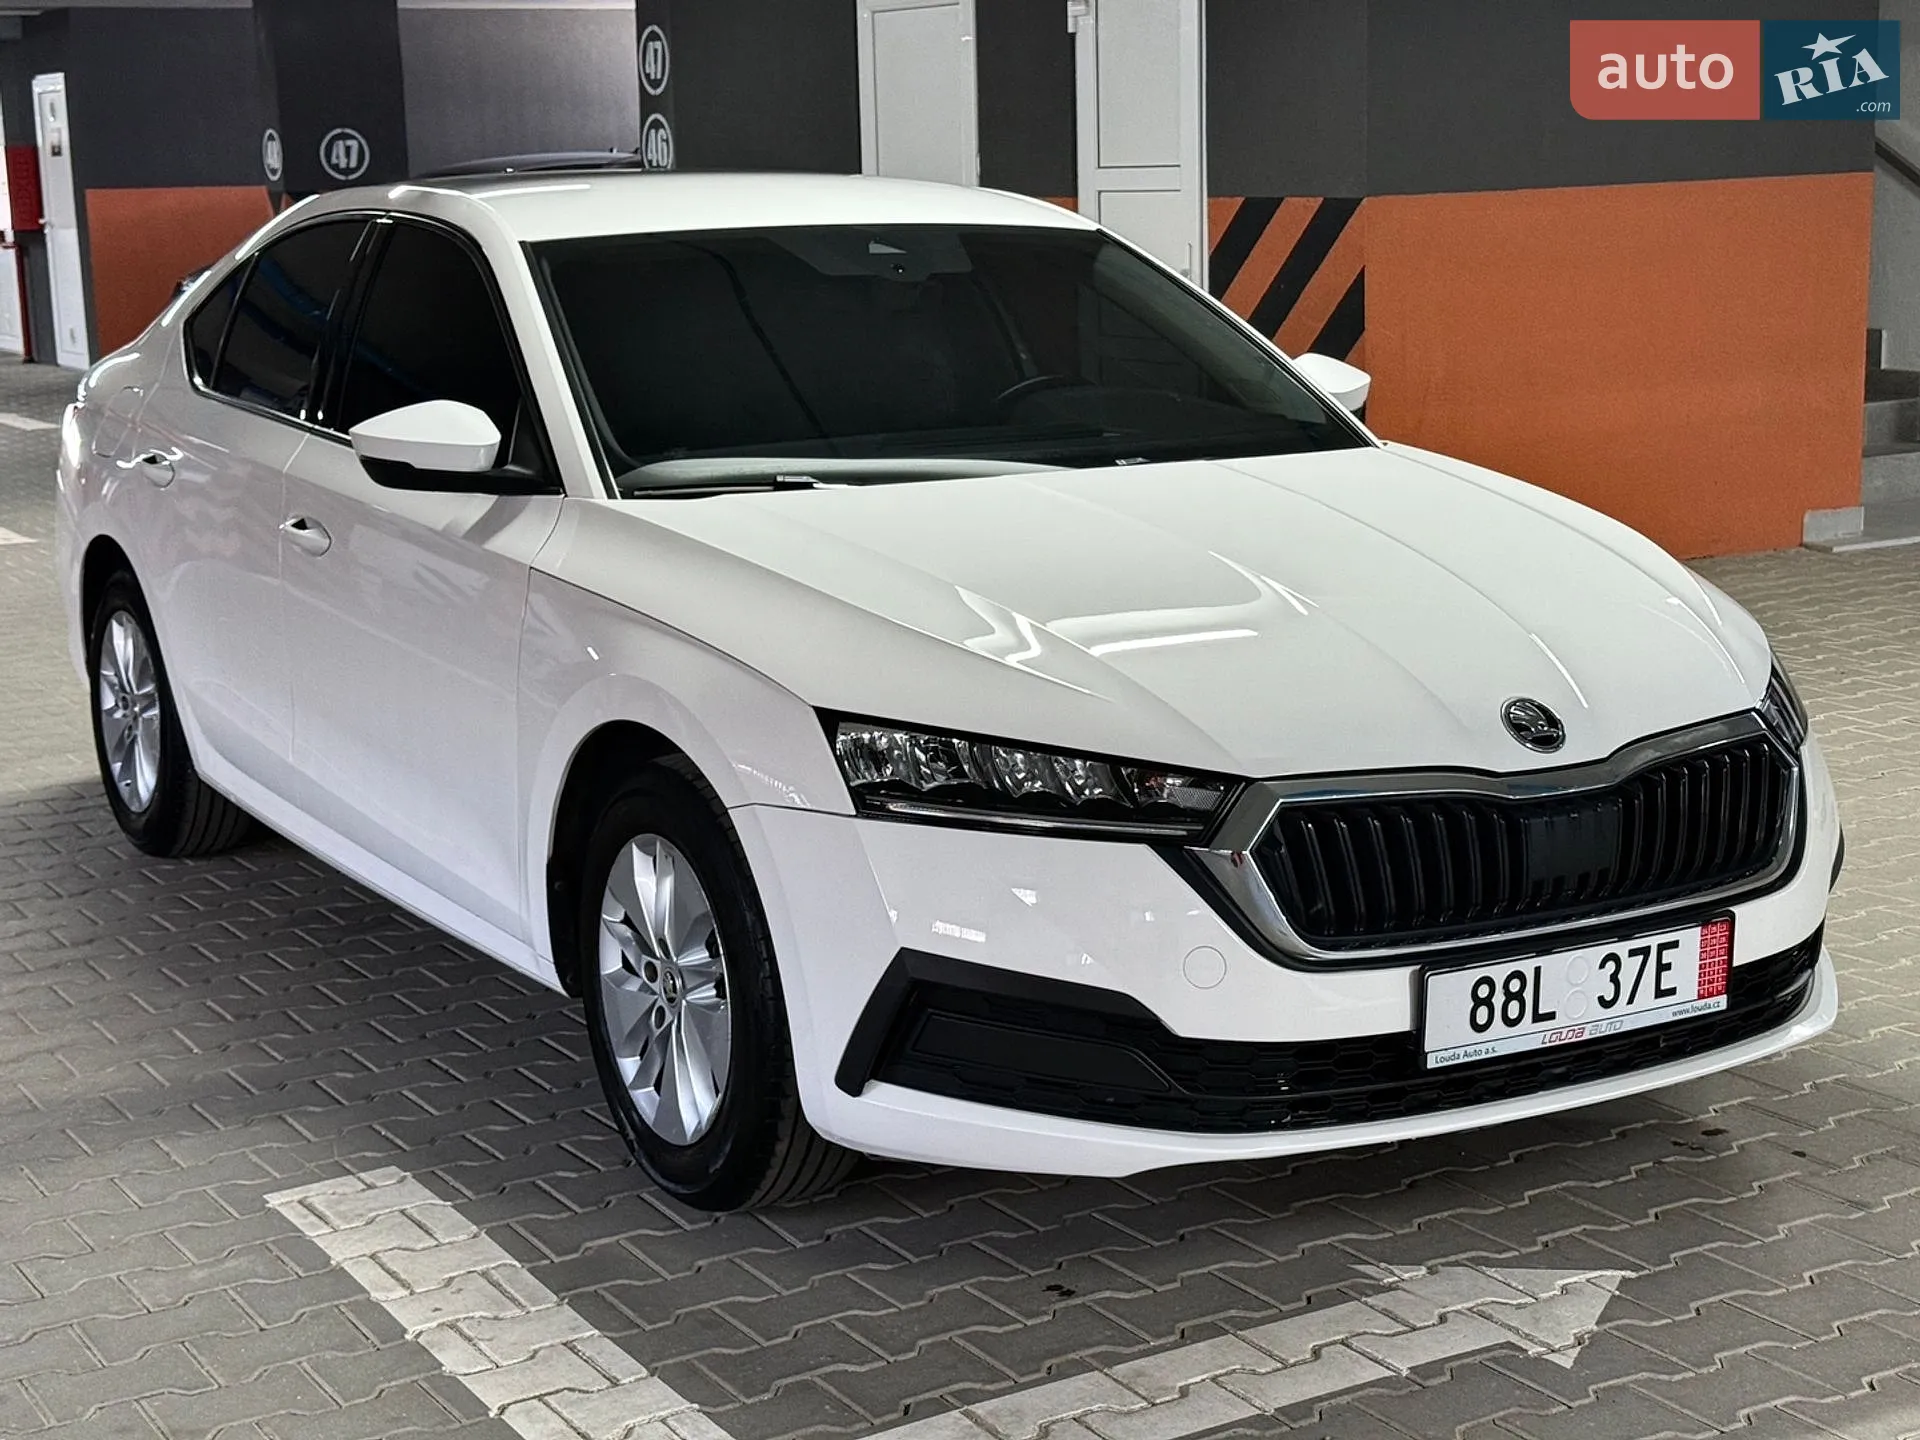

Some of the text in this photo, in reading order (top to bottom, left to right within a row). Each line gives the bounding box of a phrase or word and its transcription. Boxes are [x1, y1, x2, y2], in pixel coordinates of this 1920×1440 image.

[646, 40, 663, 79] 47
[330, 140, 359, 168] 47
[648, 128, 668, 167] 46
[1469, 965, 1557, 1033] 88L
[1597, 939, 1680, 1010] 37E
[1672, 1001, 1721, 1018] www.louda.cz
[1434, 1045, 1497, 1065] Louda Auto a.s.
